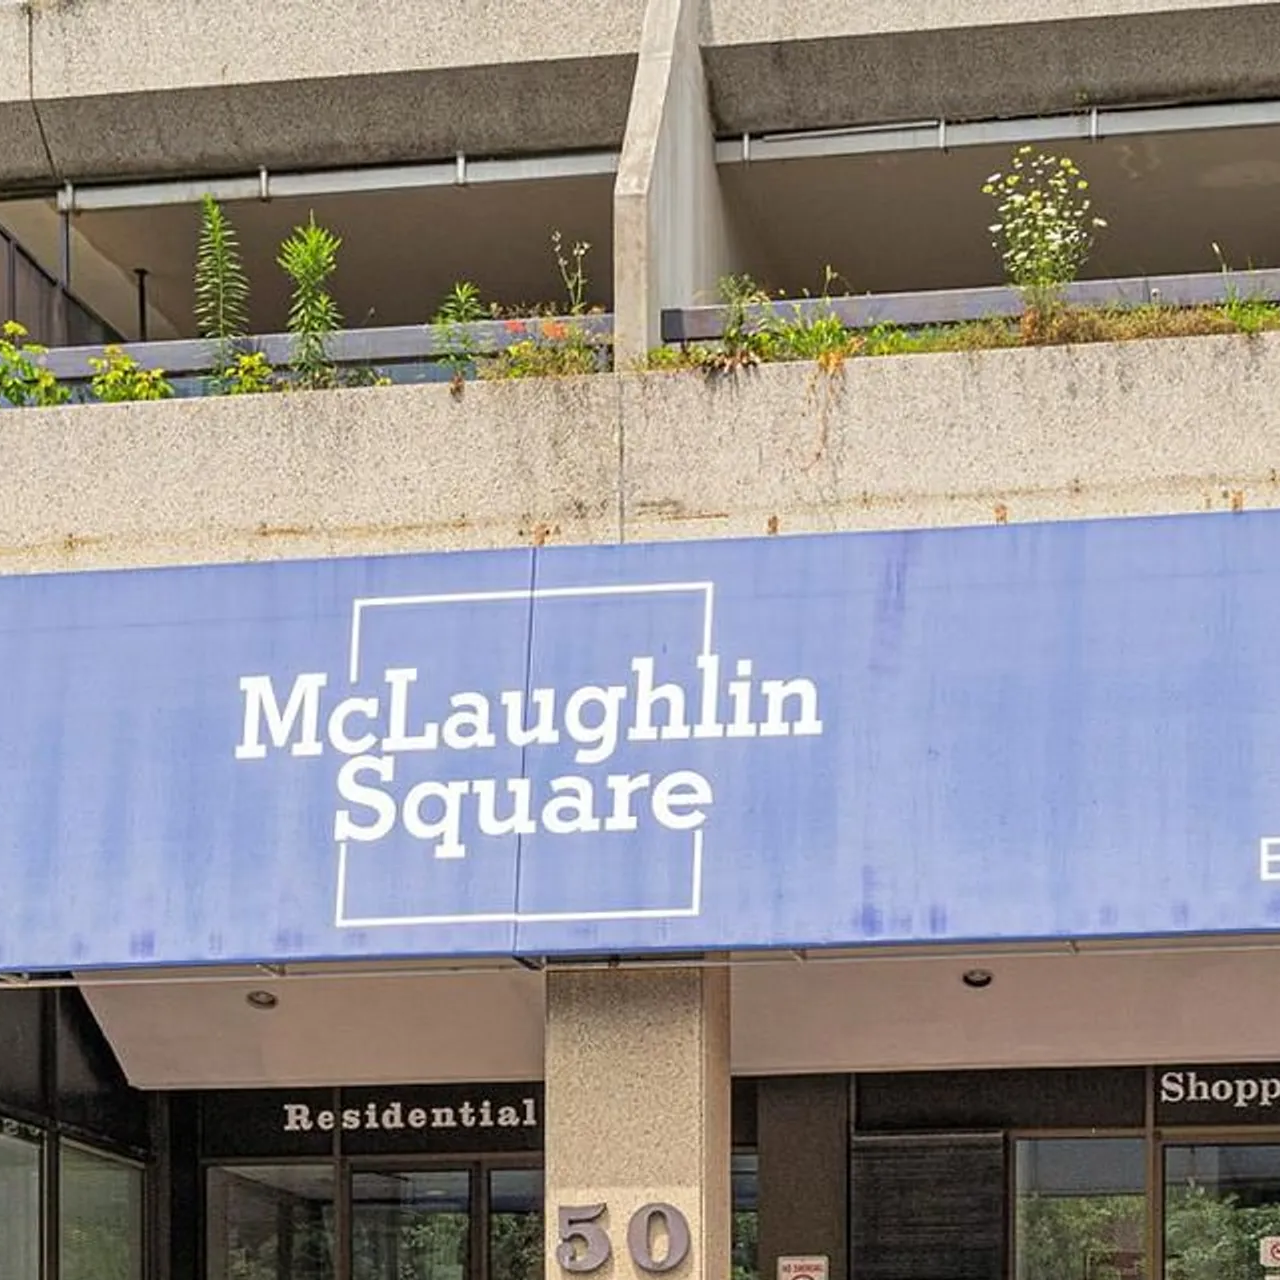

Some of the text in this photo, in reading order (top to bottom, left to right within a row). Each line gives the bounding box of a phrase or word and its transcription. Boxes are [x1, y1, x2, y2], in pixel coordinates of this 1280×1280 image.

[234, 655, 823, 764] McLaughlin
[334, 753, 714, 859] Square
[283, 1098, 538, 1131] Residential
[556, 1202, 692, 1273] 50
